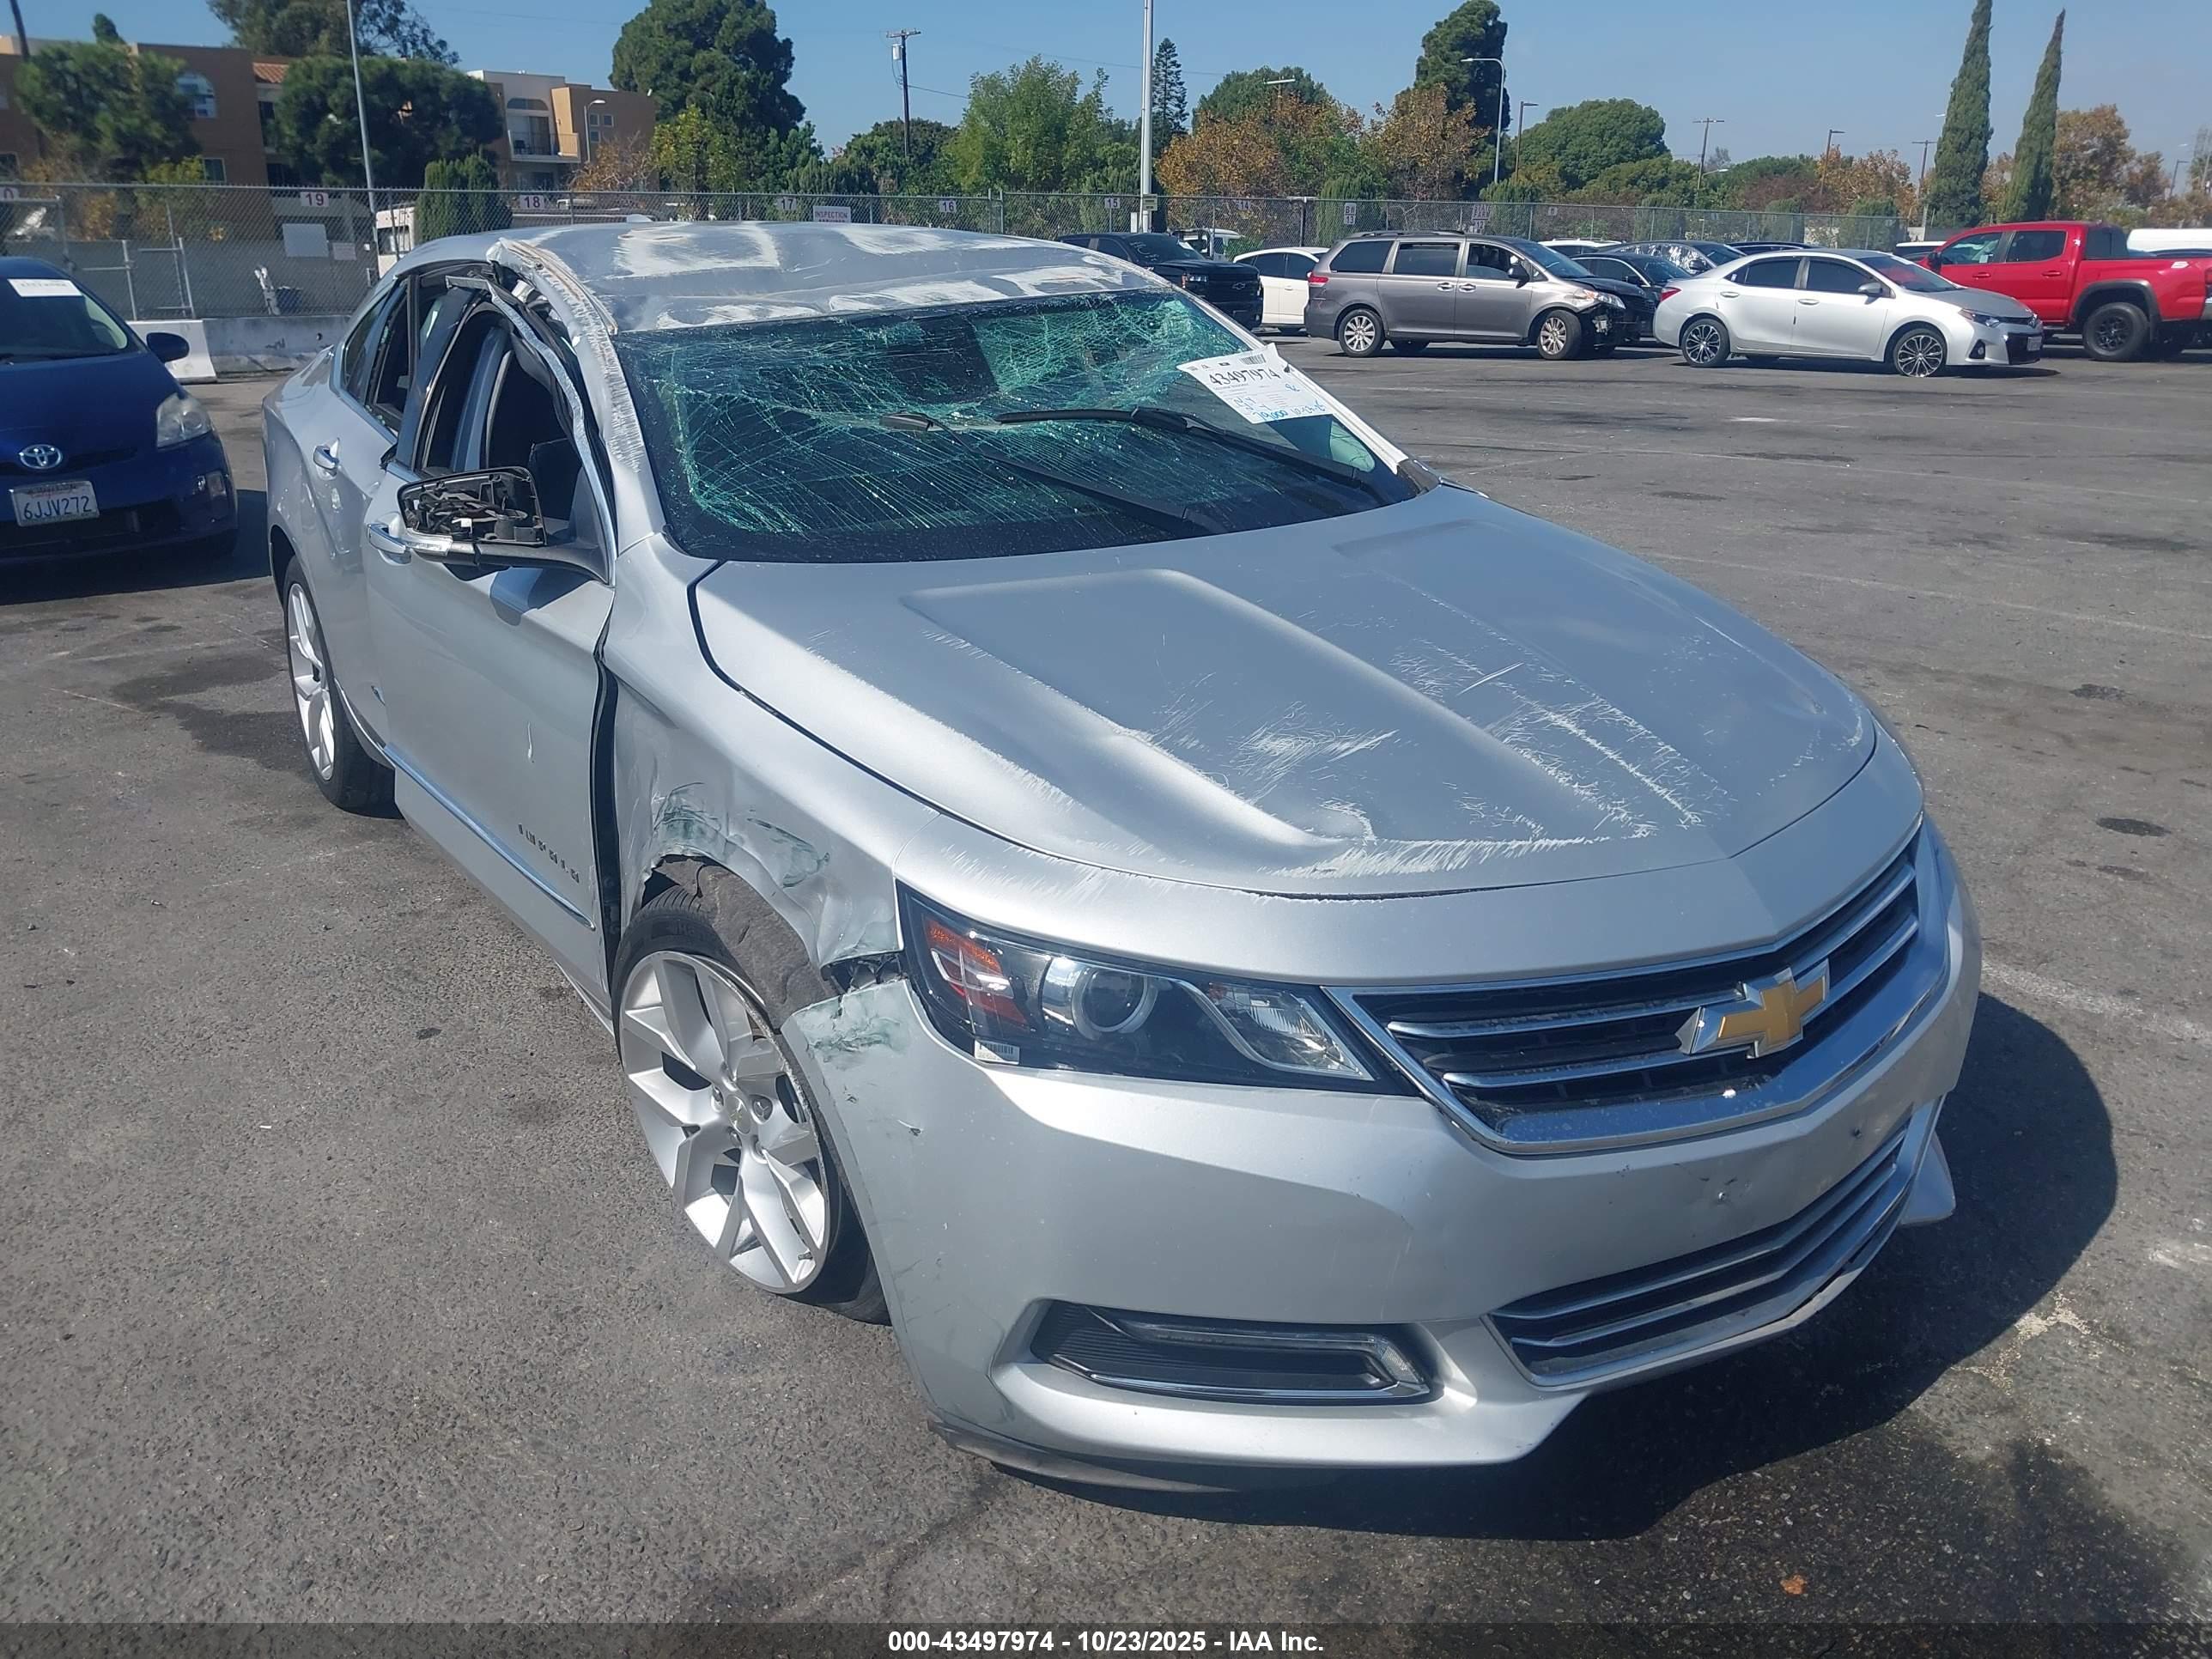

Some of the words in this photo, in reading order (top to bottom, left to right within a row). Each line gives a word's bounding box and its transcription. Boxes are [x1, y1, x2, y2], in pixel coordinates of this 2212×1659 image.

[305, 192, 325, 206] 19
[523, 196, 541, 208] 18
[781, 198, 793, 210] 17
[1107, 198, 1118, 208] 15
[942, 201, 955, 212] 16
[1346, 216, 1354, 224] 13
[1209, 368, 1282, 386] 43497974
[23, 495, 92, 520] 6JJV272
[518, 823, 580, 884] IMPALA
